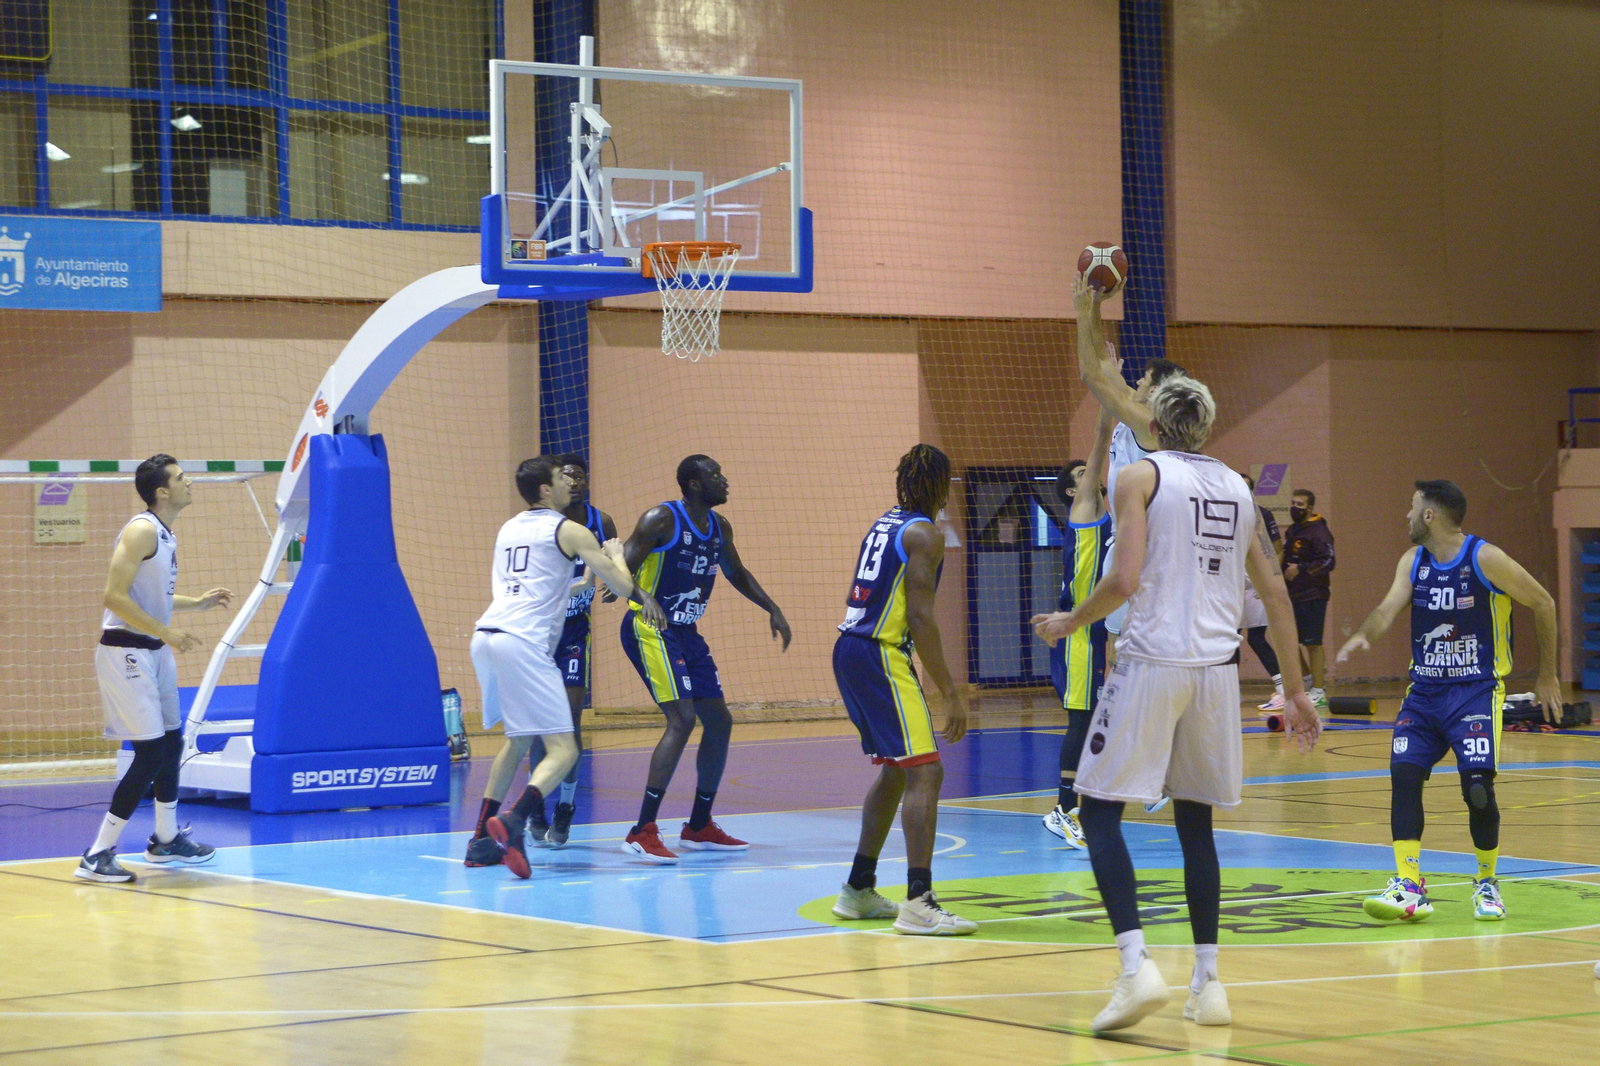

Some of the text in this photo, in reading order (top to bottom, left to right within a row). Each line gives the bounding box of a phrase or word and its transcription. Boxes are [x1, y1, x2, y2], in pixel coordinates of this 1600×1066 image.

[35, 257, 129, 272] Ayuntamiento
[35, 272, 129, 290] de Algeciras
[39, 518, 81, 526] Vestuarios
[1189, 497, 1239, 540] 19
[505, 545, 530, 573] 10
[691, 555, 708, 575] 12
[856, 531, 889, 581] 13
[1428, 587, 1455, 610] 30
[1434, 639, 1478, 654] ENER
[568, 658, 579, 673] 0
[1424, 653, 1479, 667] DRINK
[1447, 664, 1481, 677] DRINK
[1462, 737, 1490, 755] 30
[291, 764, 438, 788] SPORTSYSTEM
